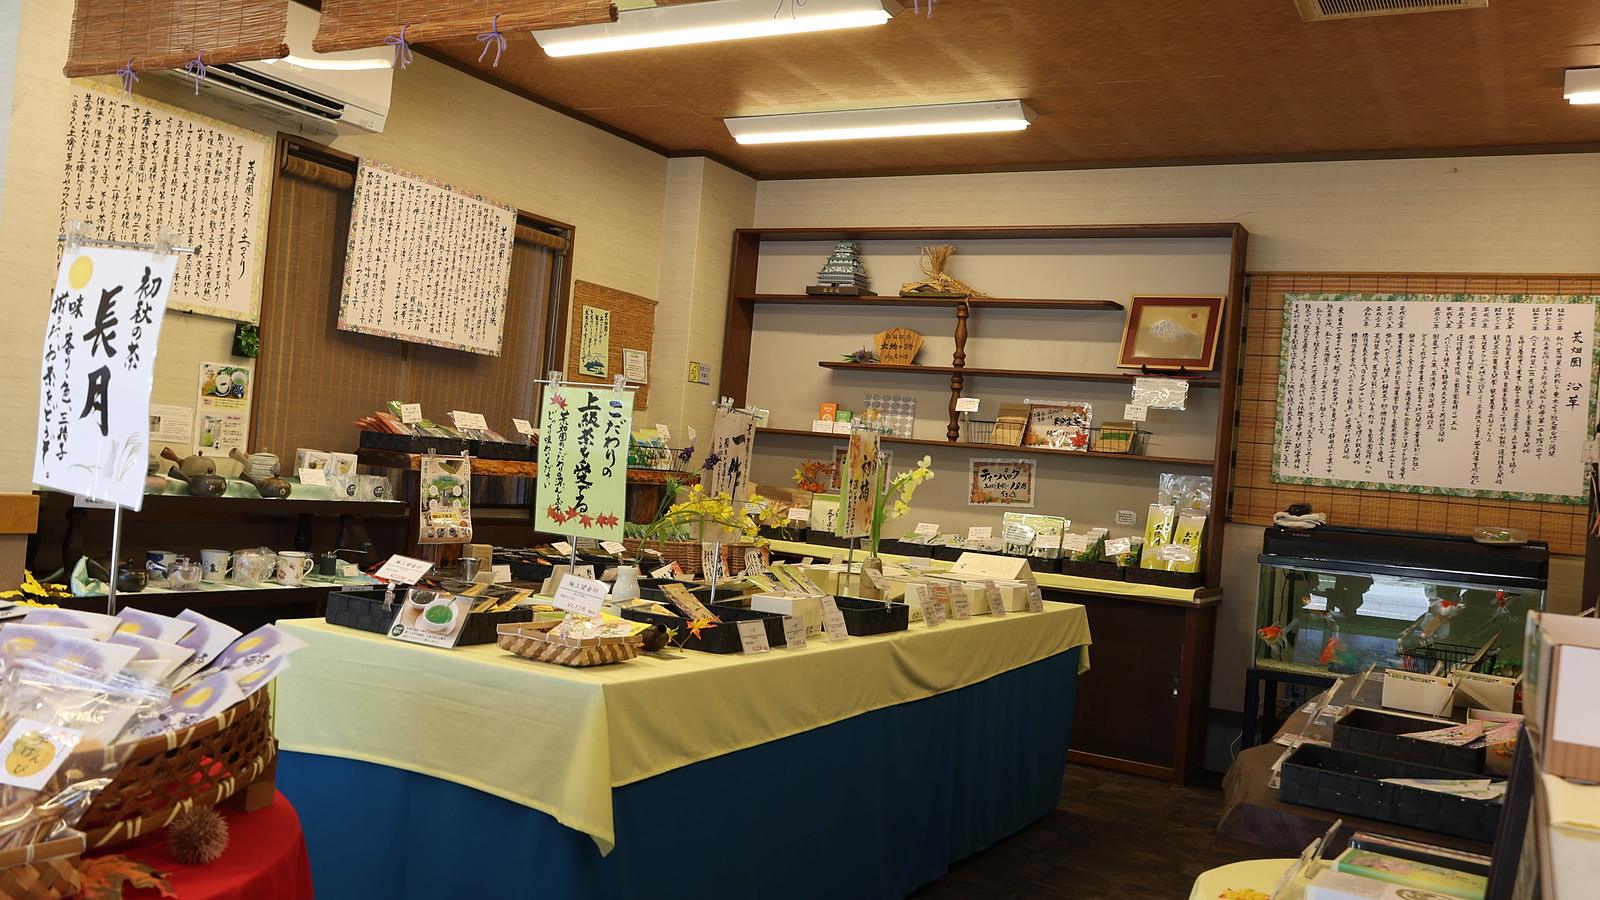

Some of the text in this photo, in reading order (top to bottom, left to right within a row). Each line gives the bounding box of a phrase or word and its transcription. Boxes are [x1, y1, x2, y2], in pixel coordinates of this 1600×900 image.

[79, 285, 123, 437] 長月
[124, 266, 162, 370] 初秋の茶
[1564, 330, 1584, 411] 荒畑園 沿革
[573, 391, 601, 513] 上級茶を愛でる
[602, 400, 627, 478] こだわりの
